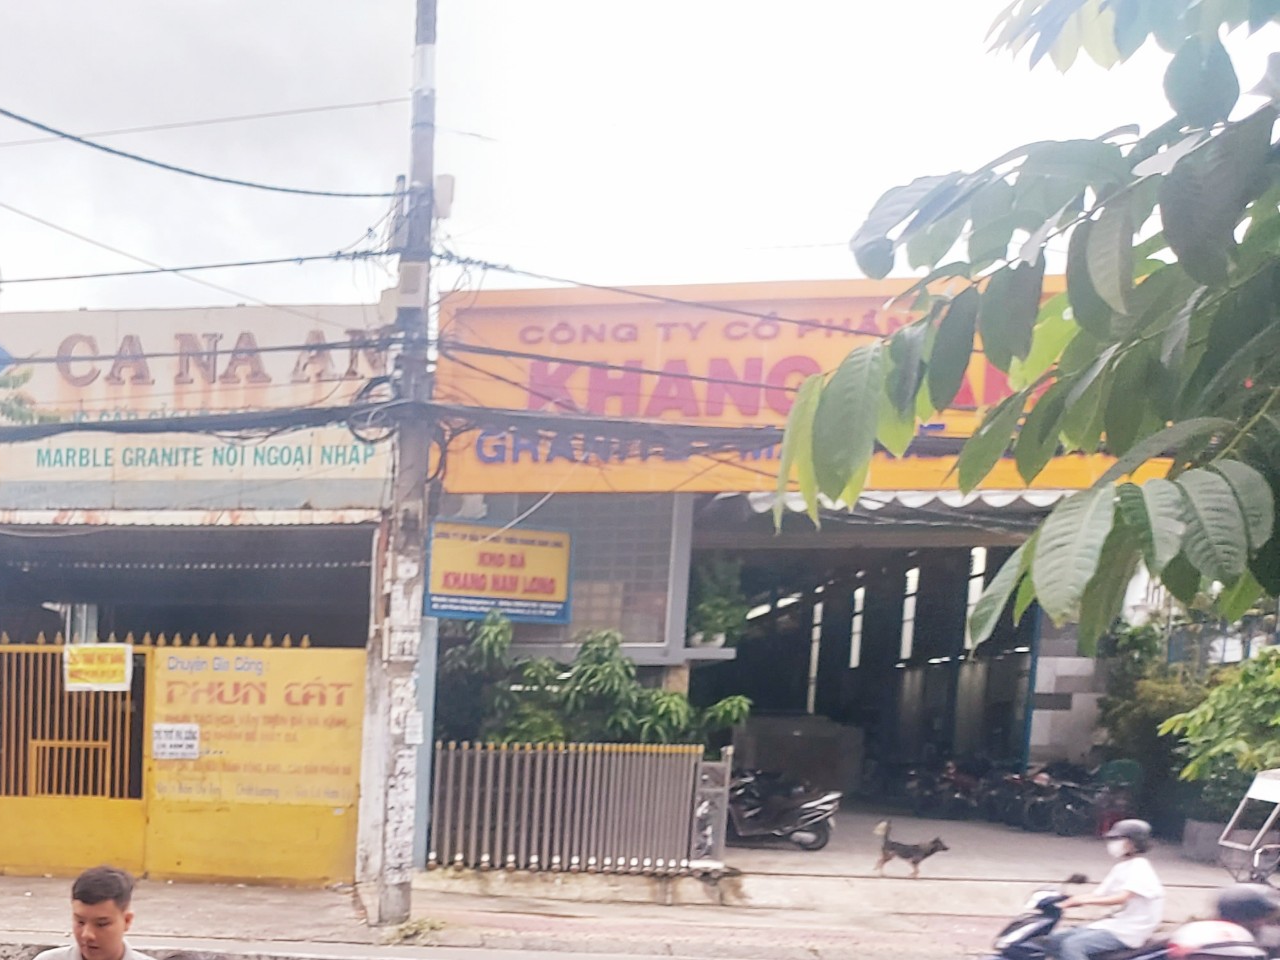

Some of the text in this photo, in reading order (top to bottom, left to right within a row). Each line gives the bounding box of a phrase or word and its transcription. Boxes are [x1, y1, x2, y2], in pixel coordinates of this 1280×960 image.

[519, 322, 640, 345] CÔNG
[656, 320, 708, 343] TY
[56, 333, 156, 387] CA
[173, 331, 272, 386] NA
[36, 447, 114, 468] MARBLE
[122, 447, 203, 468] GRANITE
[166, 676, 353, 707] PHUN CÁT
